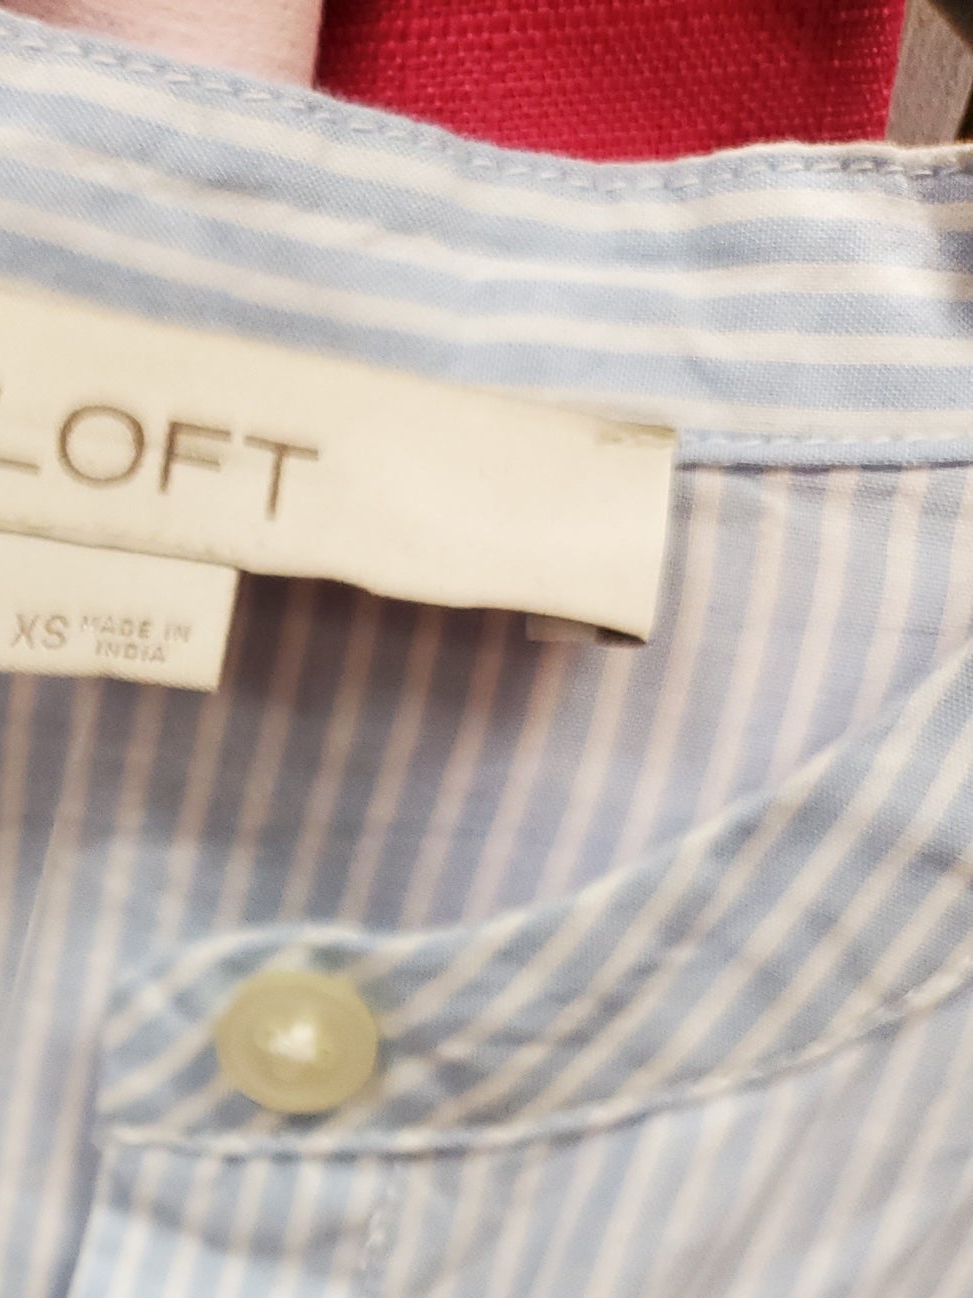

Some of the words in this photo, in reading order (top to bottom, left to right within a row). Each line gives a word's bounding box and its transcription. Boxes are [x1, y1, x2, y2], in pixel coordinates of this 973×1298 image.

[12, 612, 70, 650] XS
[80, 615, 151, 640] MADE
[163, 624, 194, 644] IN
[94, 639, 167, 664] INDIA
